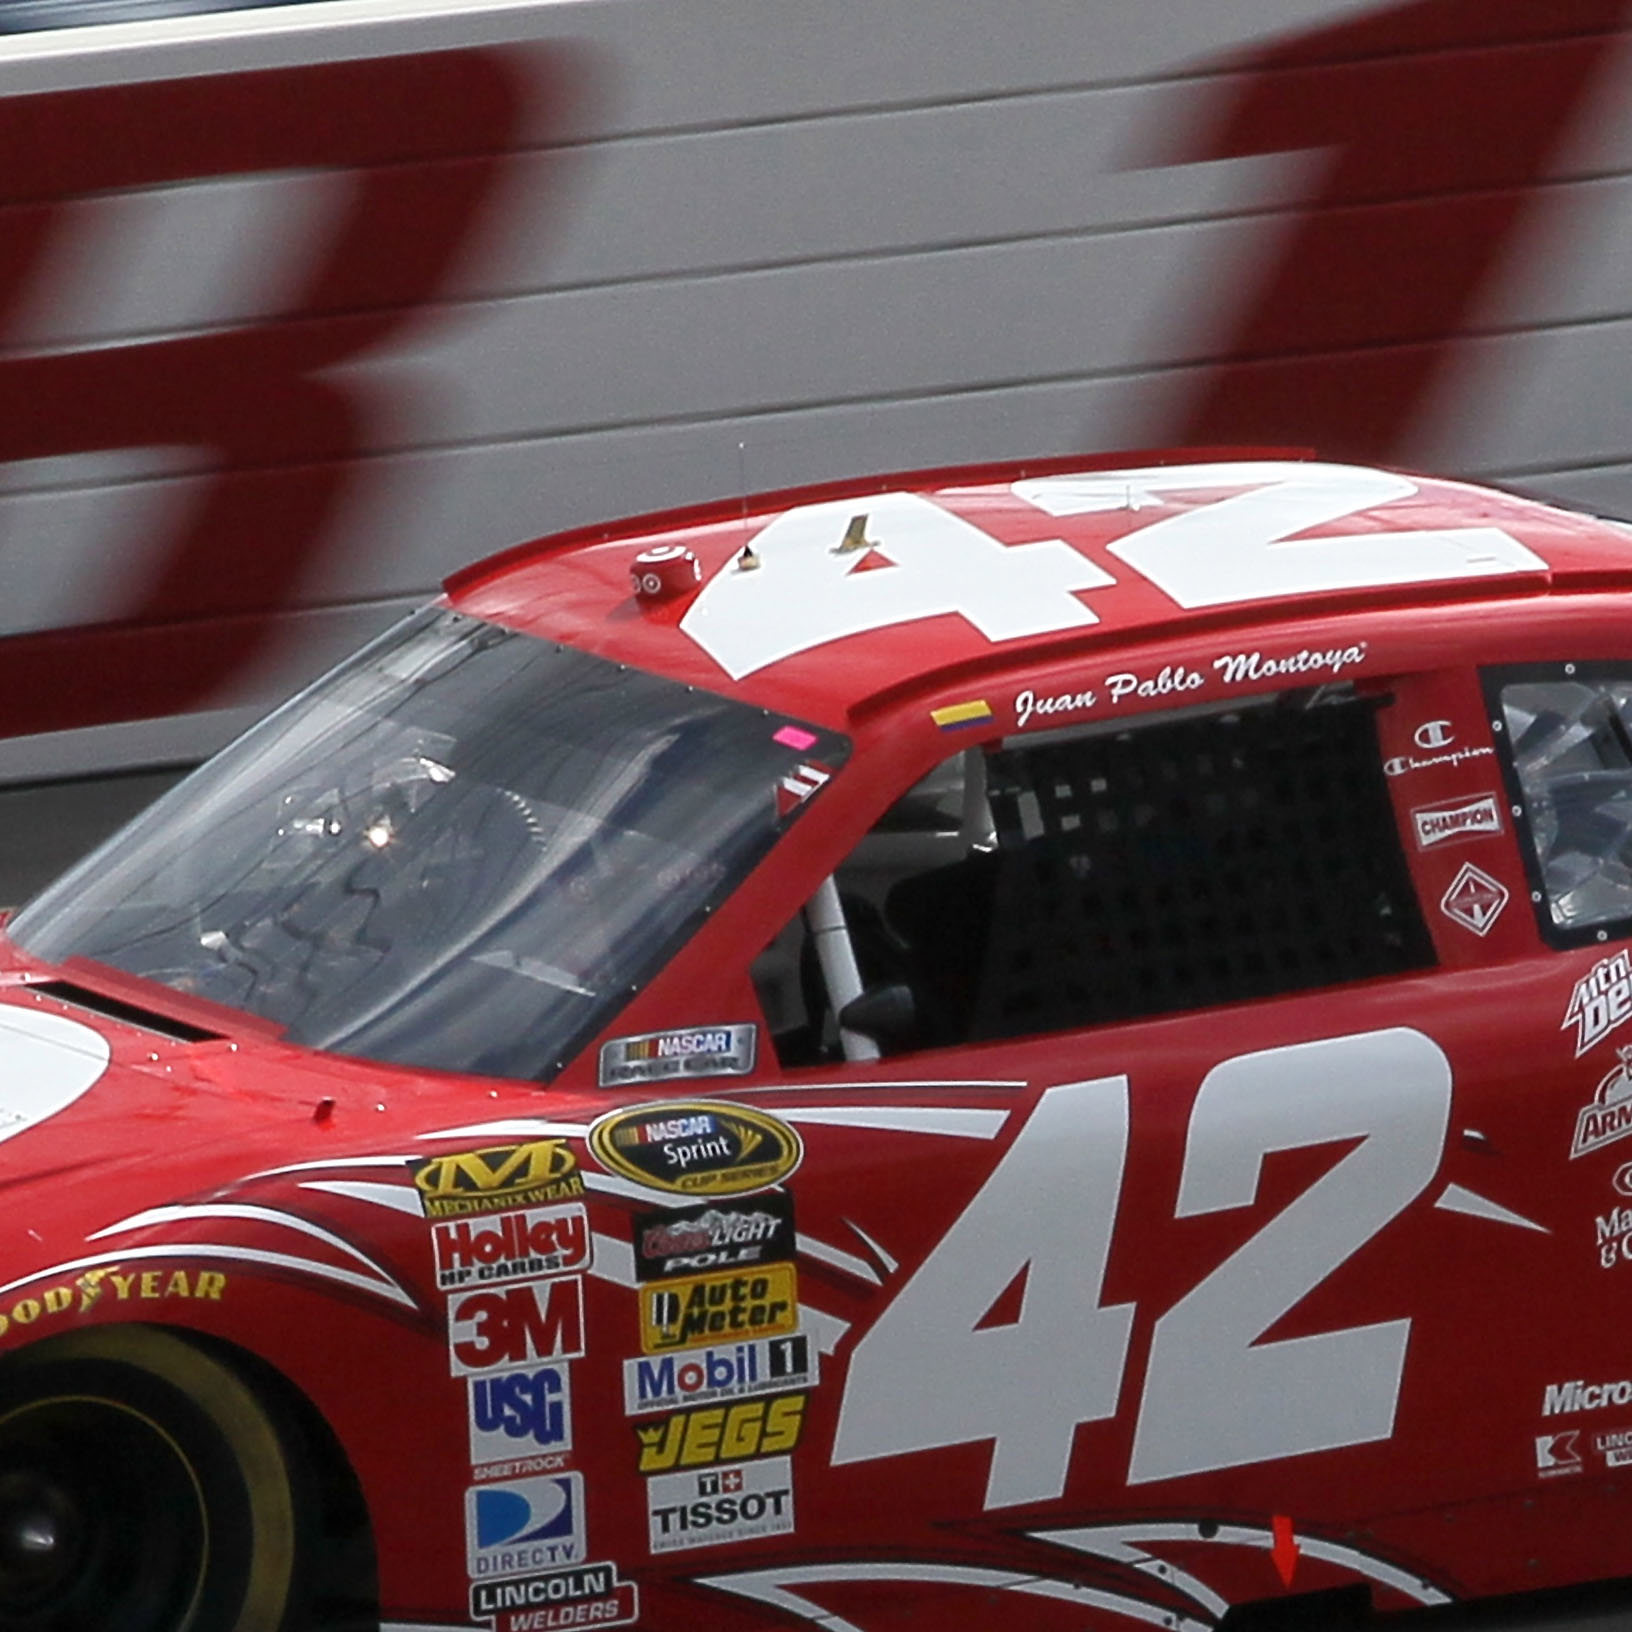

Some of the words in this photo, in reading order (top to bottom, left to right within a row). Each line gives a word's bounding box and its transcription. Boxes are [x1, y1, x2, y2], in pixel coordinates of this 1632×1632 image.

[679, 463, 1548, 680] 42
[1015, 691, 1096, 726] Juan
[1105, 667, 1204, 704] Pablo
[1213, 643, 1368, 684] Montoya
[1384, 745, 1495, 776] Champion
[1421, 808, 1495, 837] CHAMPION
[657, 1030, 729, 1057] NASCAR
[645, 1115, 713, 1143] NASCAR
[663, 1135, 732, 1169] Sprint
[425, 1193, 529, 1218] MECHANIX
[528, 1176, 586, 1204] WEAR
[435, 1213, 587, 1271] Holley
[709, 1217, 783, 1247] LIGHT
[440, 1269, 472, 1287] HP
[478, 1255, 561, 1281] CARBS
[664, 1246, 764, 1273] POLE
[829, 1026, 1454, 1512] 42
[686, 1278, 770, 1310] Auto
[453, 1279, 582, 1369] 3M
[638, 1343, 758, 1400] Mobil
[780, 1341, 793, 1374] 1
[473, 1367, 565, 1446] USG
[638, 1396, 806, 1472] JEGS
[473, 1455, 566, 1481] SHEETROCK
[651, 1489, 790, 1535] TISSOT
[475, 1543, 576, 1575] DIRECTV
[478, 1571, 607, 1612] LINCOLN
